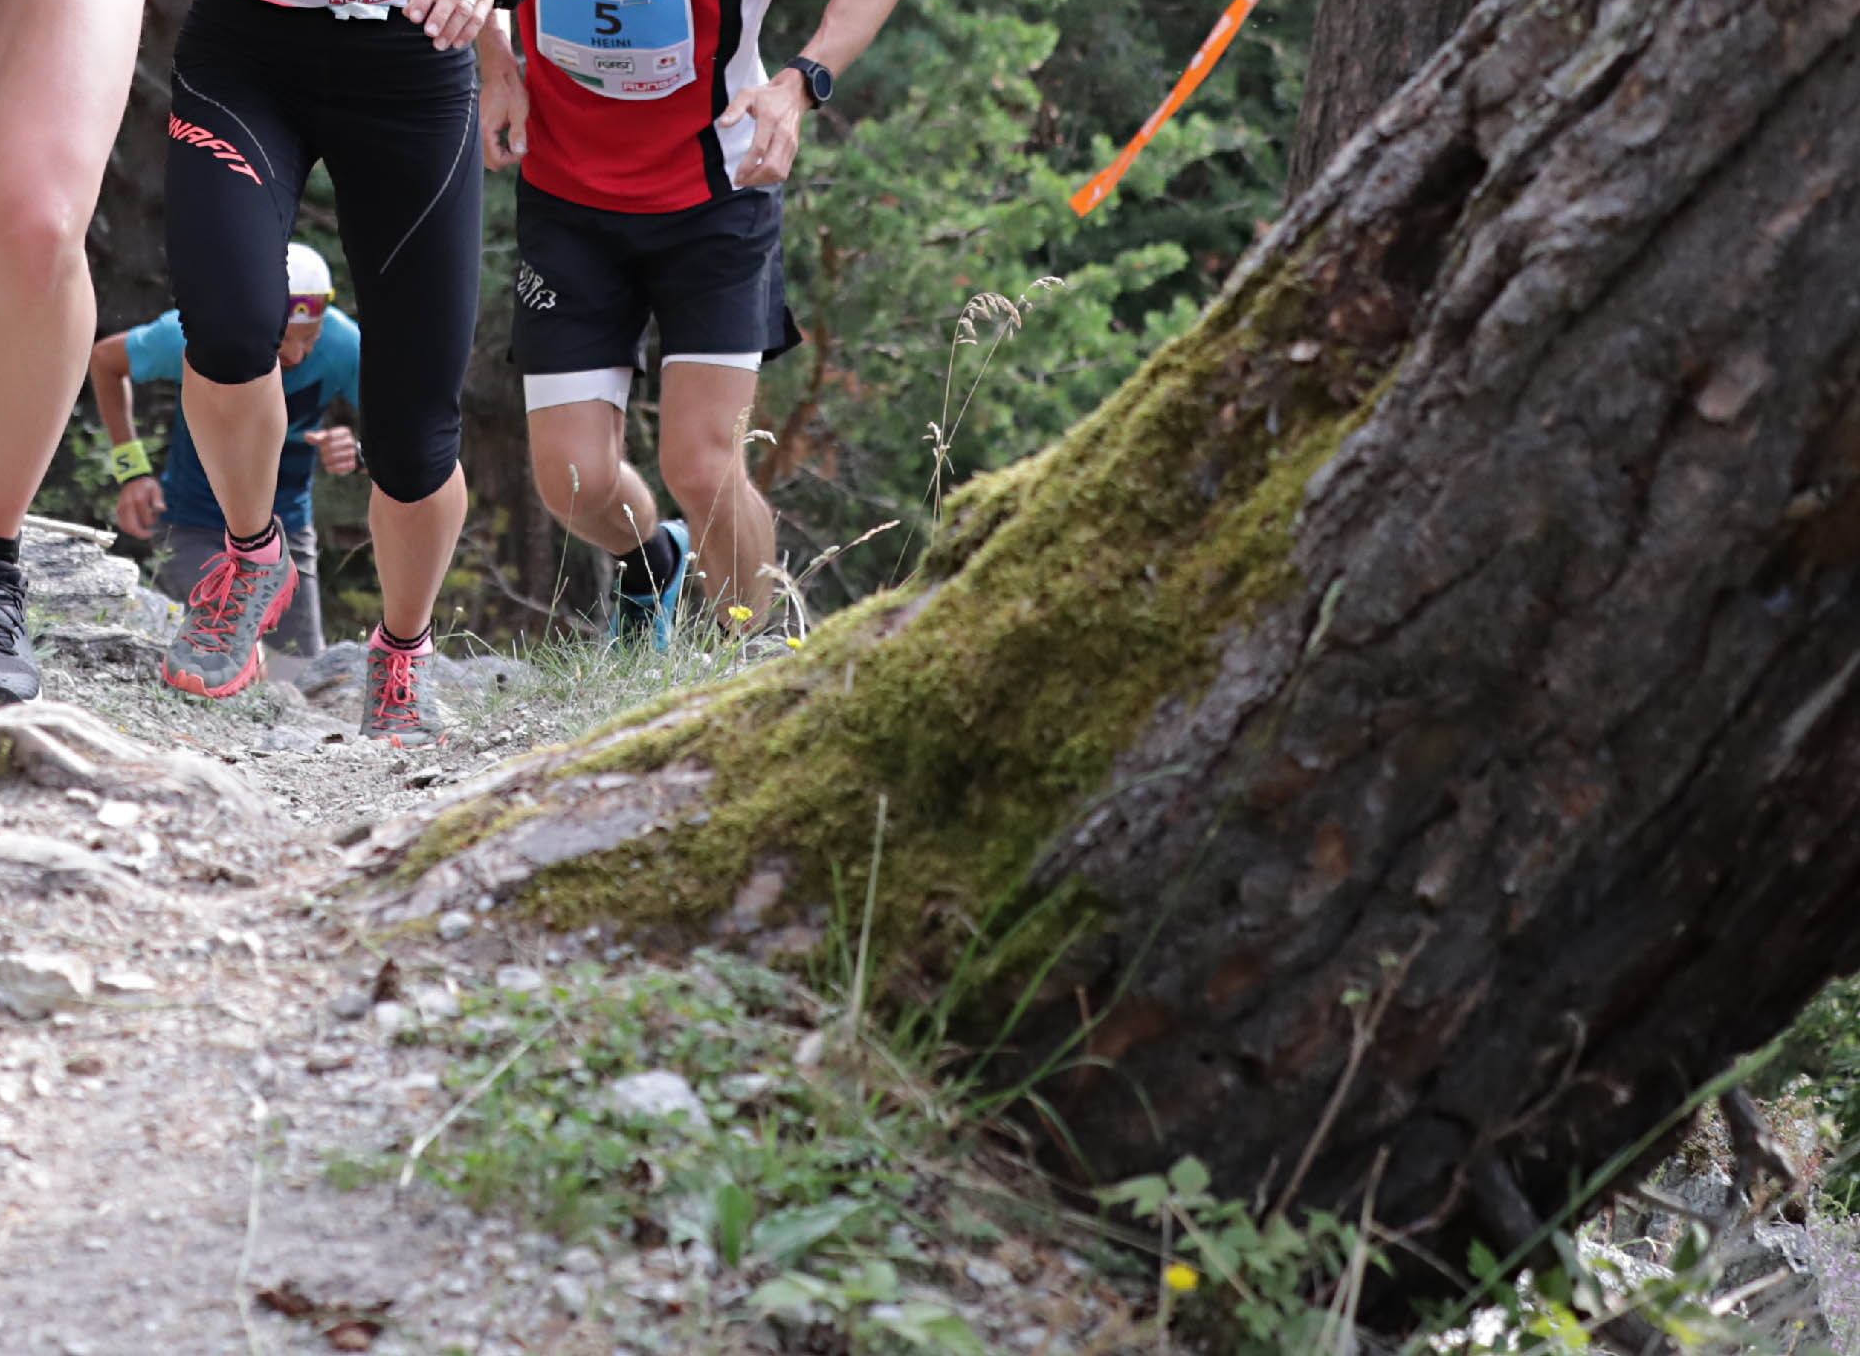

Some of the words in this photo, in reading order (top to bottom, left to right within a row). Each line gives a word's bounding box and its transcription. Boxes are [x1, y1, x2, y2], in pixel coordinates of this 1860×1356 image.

[595, 2, 622, 36] 5
[591, 37, 632, 49] HEINI
[169, 111, 262, 185] NAFIT
